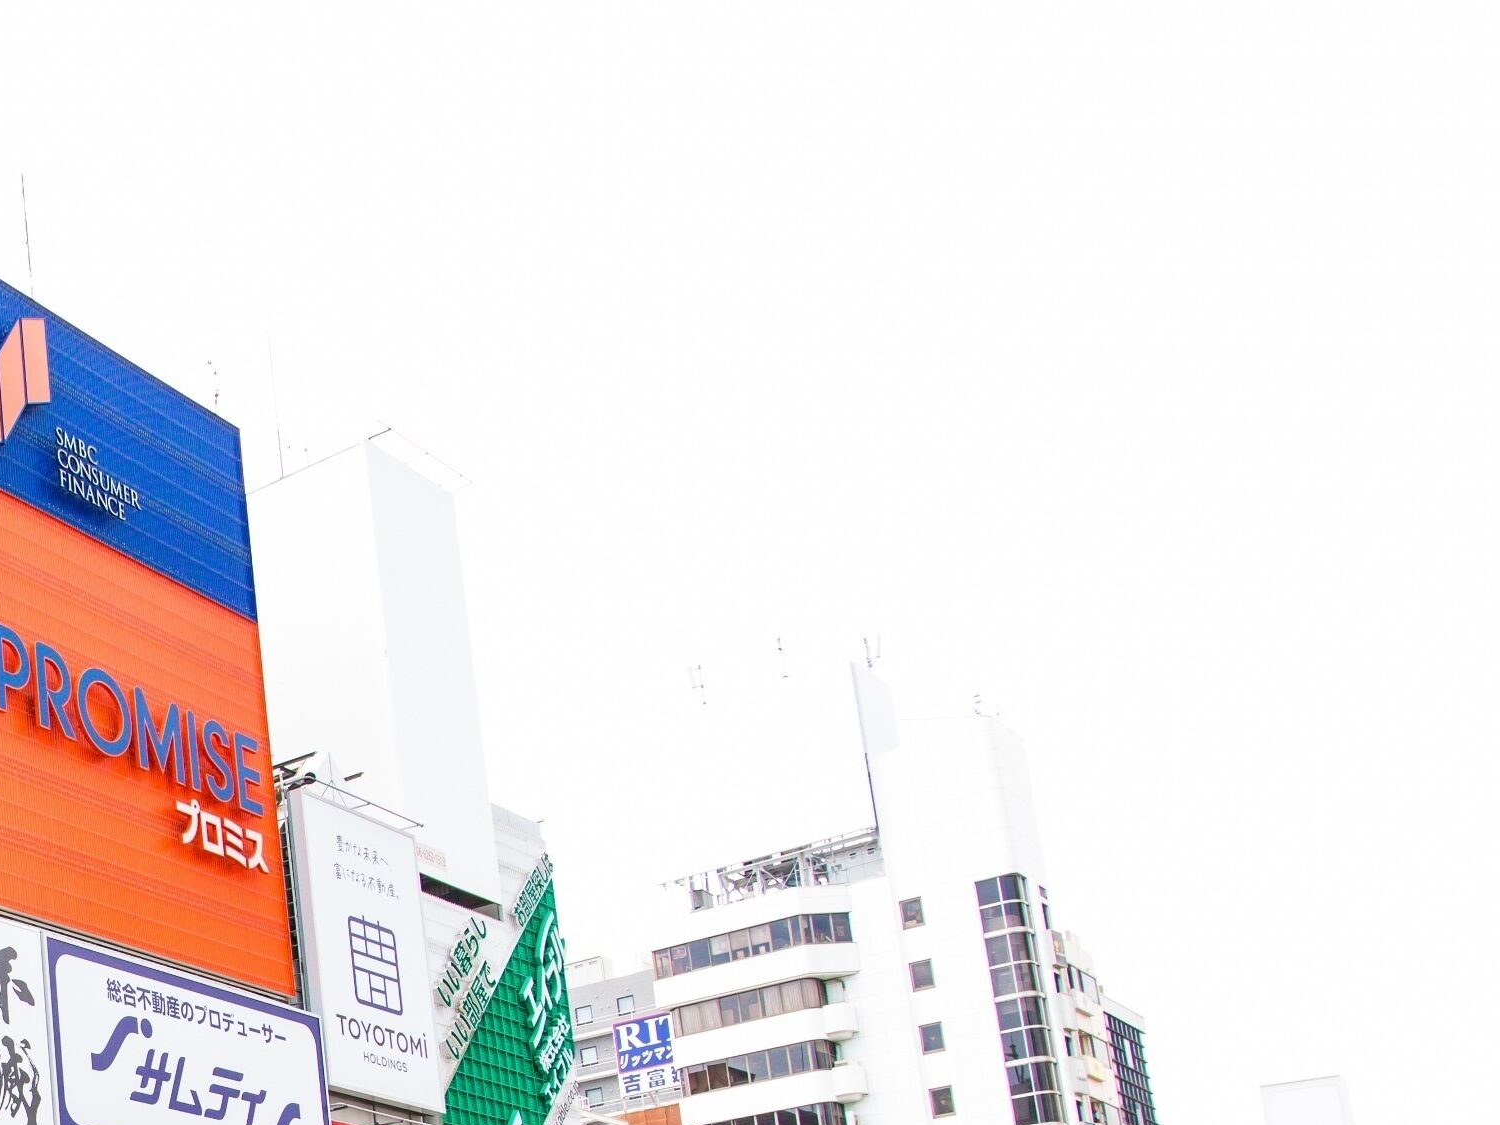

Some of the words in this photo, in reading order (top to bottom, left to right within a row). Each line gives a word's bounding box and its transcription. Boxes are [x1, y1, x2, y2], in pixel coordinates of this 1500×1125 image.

[56, 427, 98, 465] SMBC
[57, 449, 141, 510] CONSUMER
[60, 469, 125, 520] FINANCE
[175, 800, 269, 873] プロミス
[437, 917, 486, 1008] いい暮らし
[519, 915, 566, 1042] エイブル
[106, 978, 286, 1043] 総合不動産のプロデューサー
[446, 960, 496, 1060] いい部屋で
[362, 1051, 408, 1073] HOLDINGS
[541, 1049, 574, 1105] エイブル
